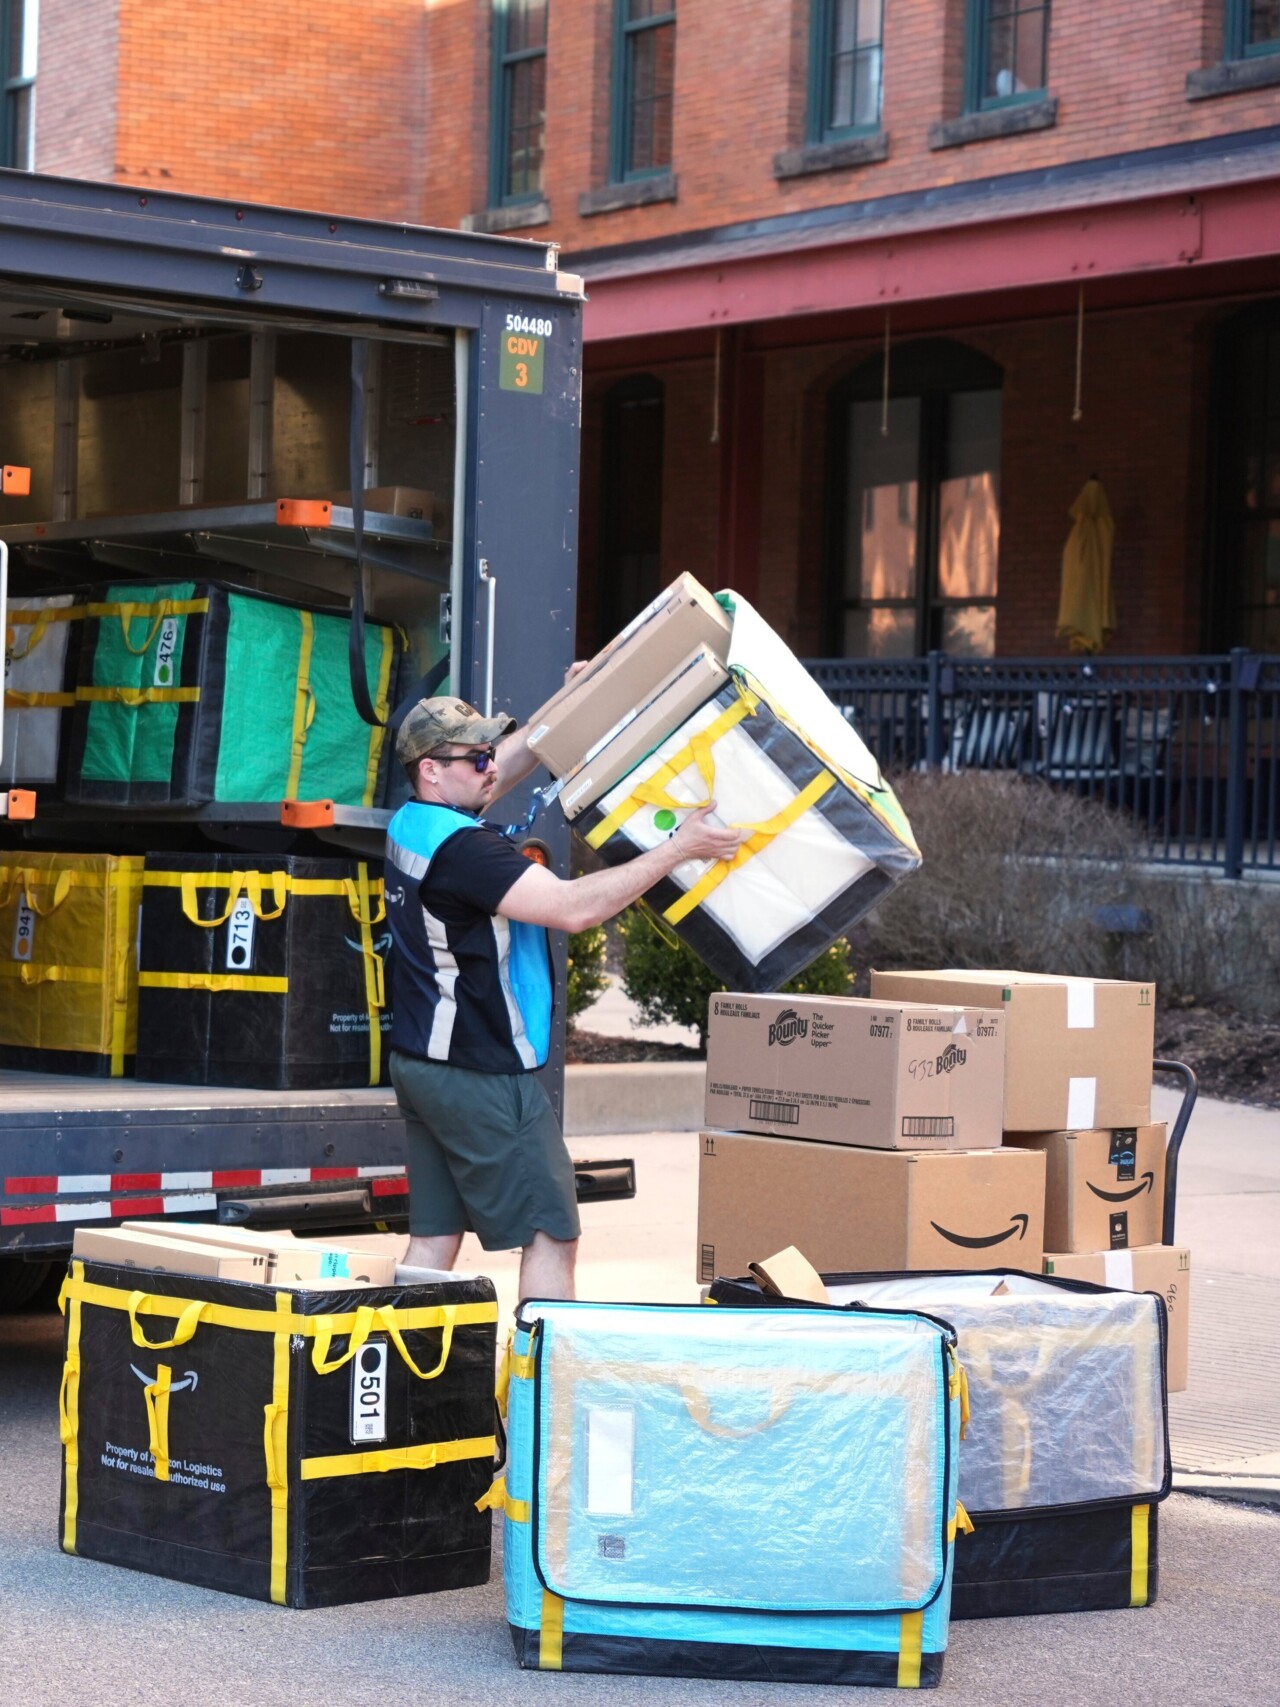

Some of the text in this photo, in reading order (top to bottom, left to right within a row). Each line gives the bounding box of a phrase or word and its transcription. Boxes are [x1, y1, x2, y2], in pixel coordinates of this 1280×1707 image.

[506, 314, 552, 337] 504480
[507, 336, 539, 356] CDV
[515, 362, 528, 388] 3
[159, 631, 173, 663] 476
[232, 910, 250, 944] 713
[714, 1001, 719, 1016] 8
[720, 1002, 748, 1011] FAMILY ROLLS
[332, 1013, 358, 1024] Property
[812, 1012, 824, 1021] The
[330, 1023, 341, 1032] Not
[342, 1023, 351, 1032] for
[768, 1016, 808, 1047] Bounty
[812, 1021, 835, 1031] Quicker
[870, 1024, 890, 1038] 07977
[907, 1018, 912, 1032] 8
[976, 1026, 995, 1037] 07977
[811, 1030, 830, 1039] Picker
[360, 1376, 380, 1418] 501
[105, 1441, 223, 1477] Property of Azon Logistics
[101, 1454, 115, 1468] Not
[116, 1458, 129, 1471] for
[210, 1481, 226, 1493] use
